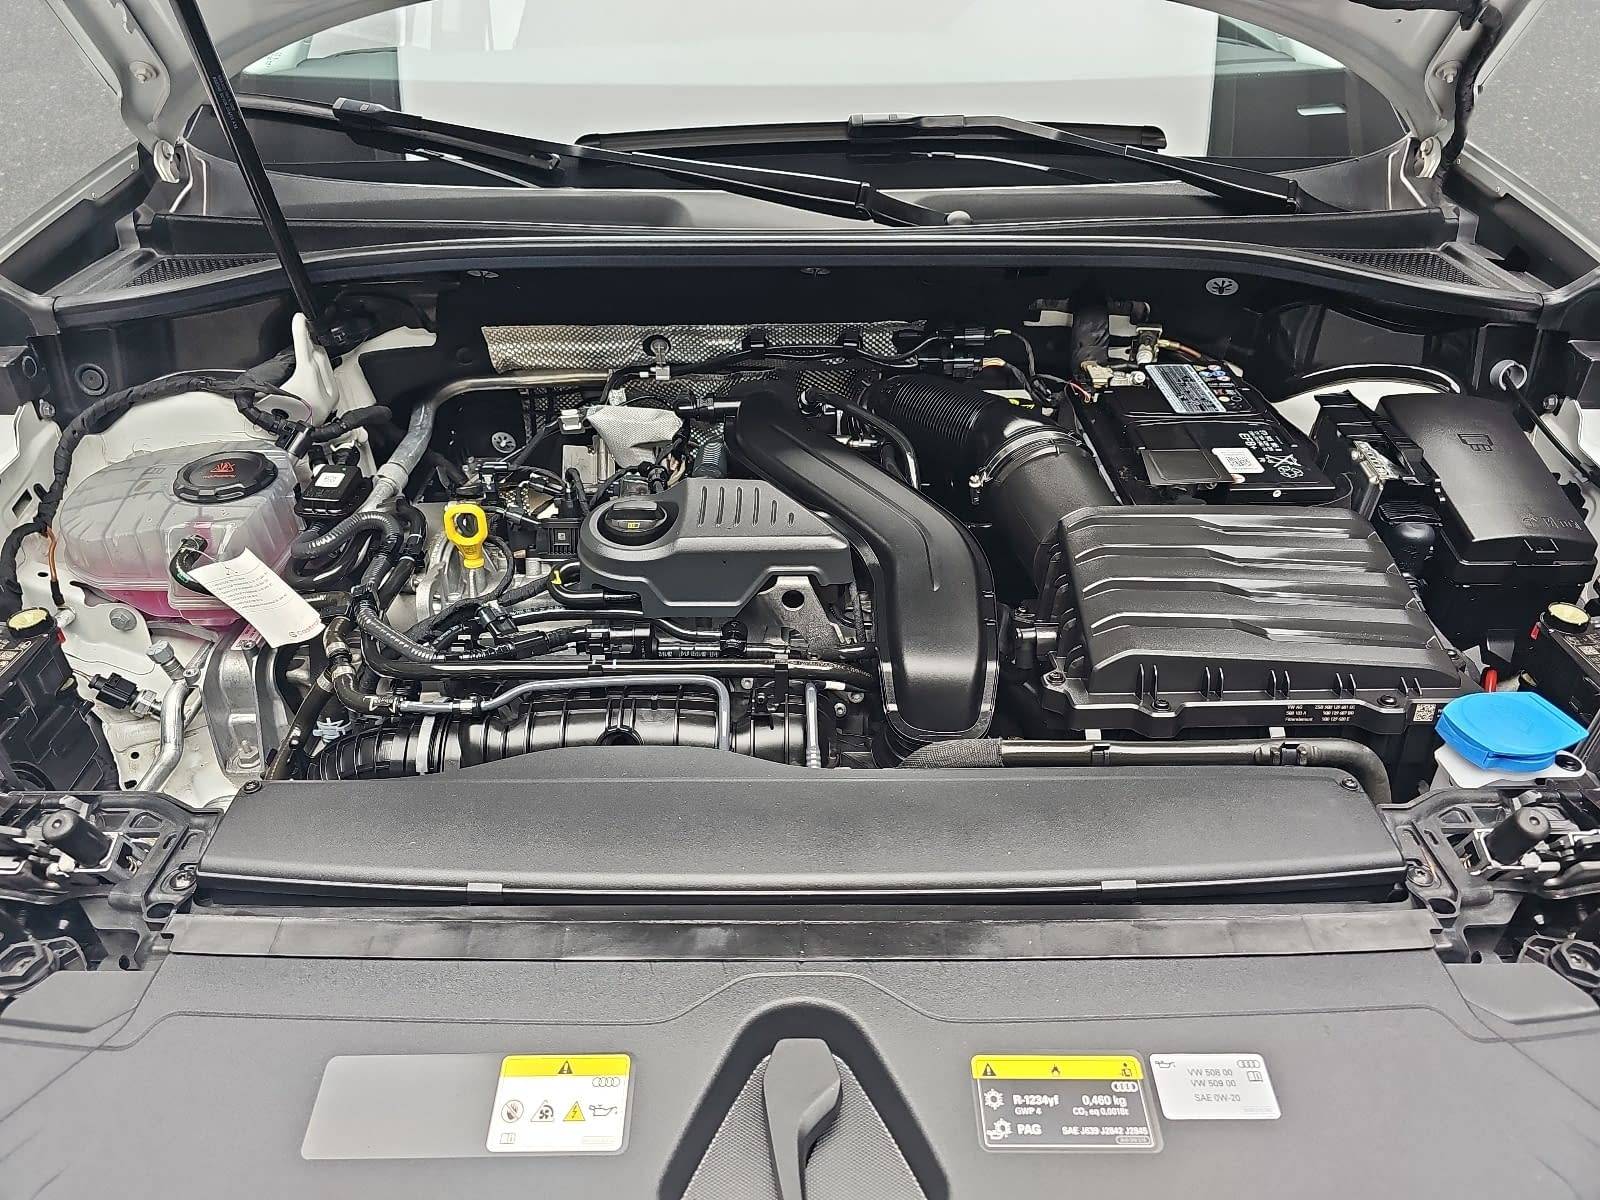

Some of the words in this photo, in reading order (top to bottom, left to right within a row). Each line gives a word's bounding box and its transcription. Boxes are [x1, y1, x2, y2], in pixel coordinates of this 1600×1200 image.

[1187, 1068, 1203, 1076] VW
[1205, 1068, 1221, 1077] 508
[1222, 1068, 1233, 1077] 00
[1190, 1079, 1206, 1087] VW
[1208, 1079, 1224, 1087] 509
[1226, 1079, 1237, 1087] 00
[1012, 1094, 1060, 1107] R-1234yf
[1081, 1094, 1112, 1107] 0,460
[1112, 1094, 1128, 1108] kg
[1194, 1093, 1213, 1102] SAE
[1214, 1093, 1241, 1102] 0W-20
[1015, 1107, 1035, 1115] GWP
[1035, 1107, 1043, 1115] 4
[1016, 1123, 1043, 1135] PAG
[1061, 1126, 1080, 1135] SAE
